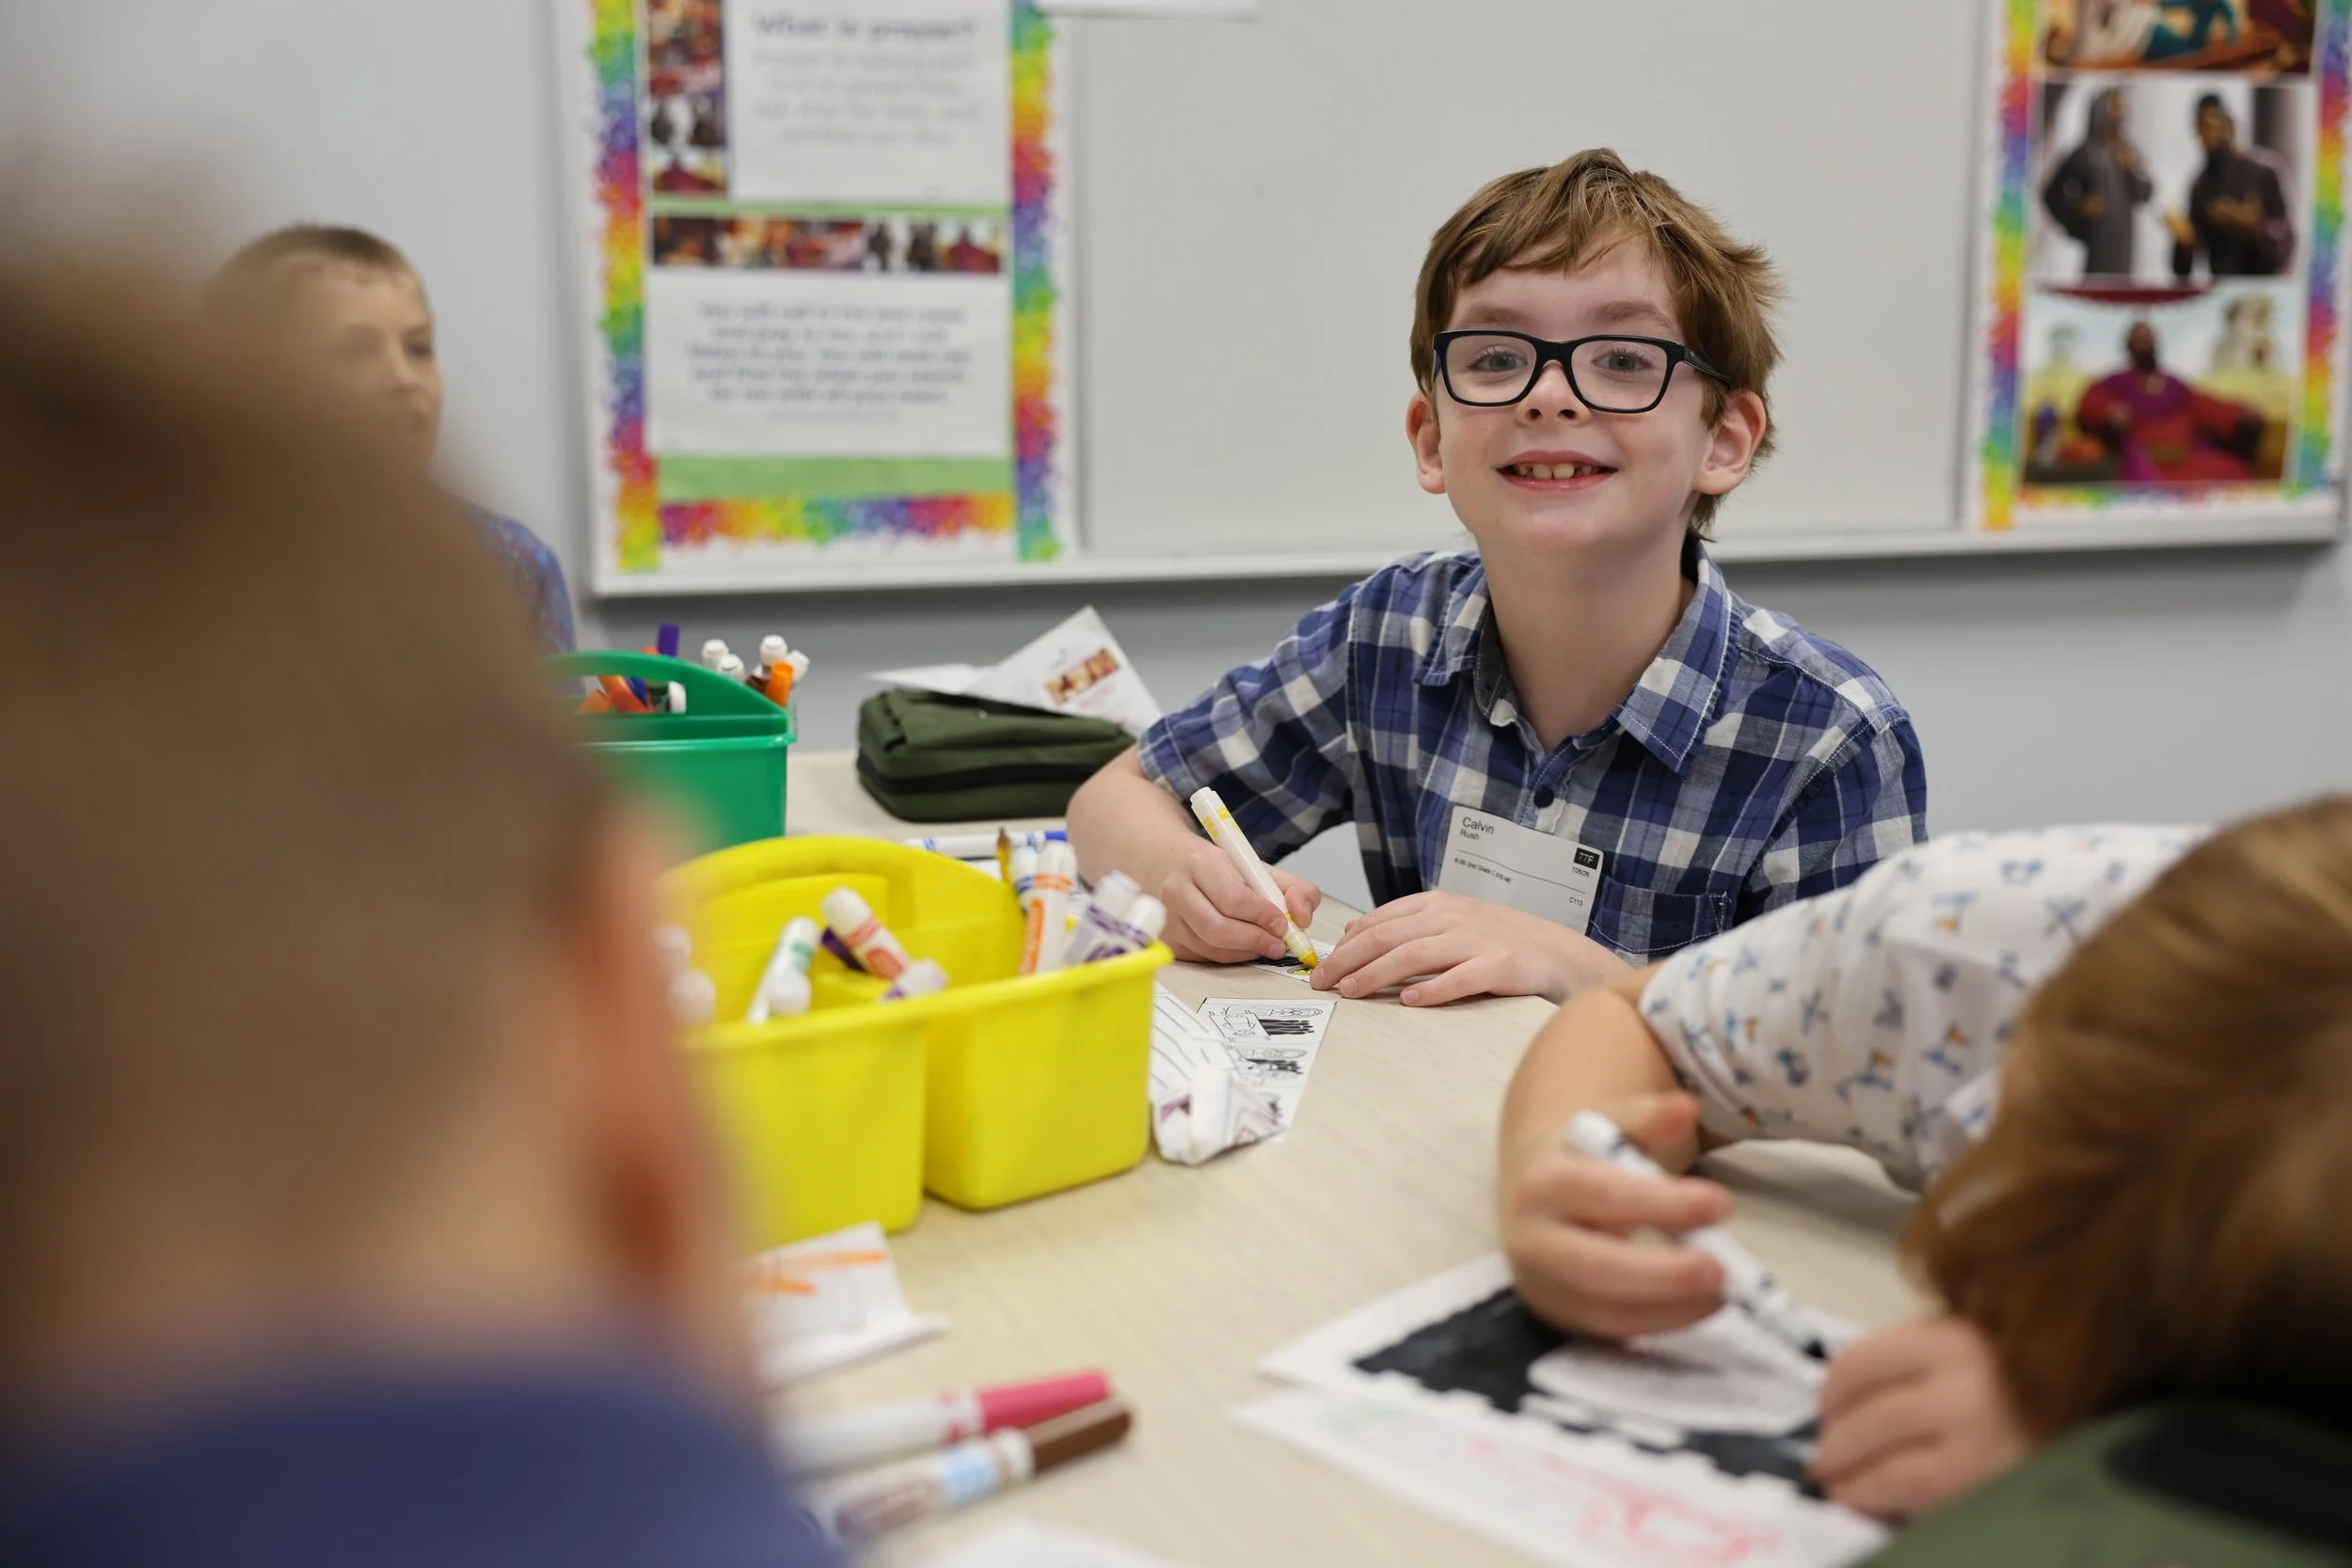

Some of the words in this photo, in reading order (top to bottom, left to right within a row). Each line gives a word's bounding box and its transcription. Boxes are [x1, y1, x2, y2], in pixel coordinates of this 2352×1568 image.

[1462, 816, 1495, 835] Calvin
[1460, 830, 1480, 841] Rush
[1579, 852, 1595, 864] 77F
